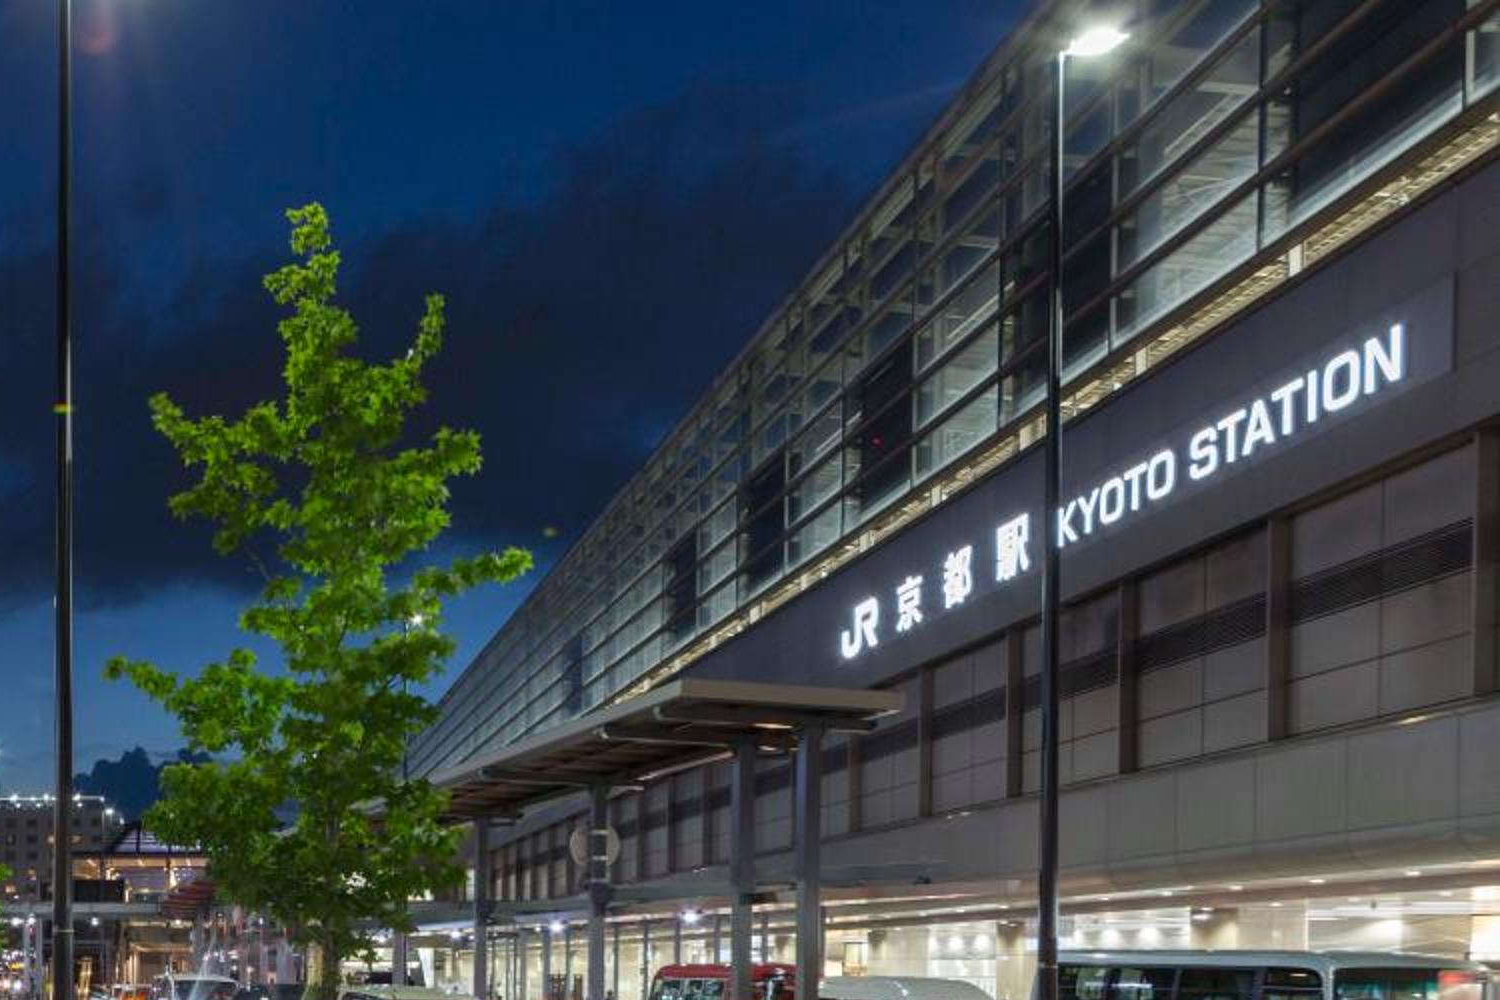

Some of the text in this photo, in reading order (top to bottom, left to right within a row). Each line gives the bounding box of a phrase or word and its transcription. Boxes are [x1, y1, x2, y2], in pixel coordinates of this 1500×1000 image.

[841, 323, 1403, 659] JR 京都駅 KYOTO STATION
